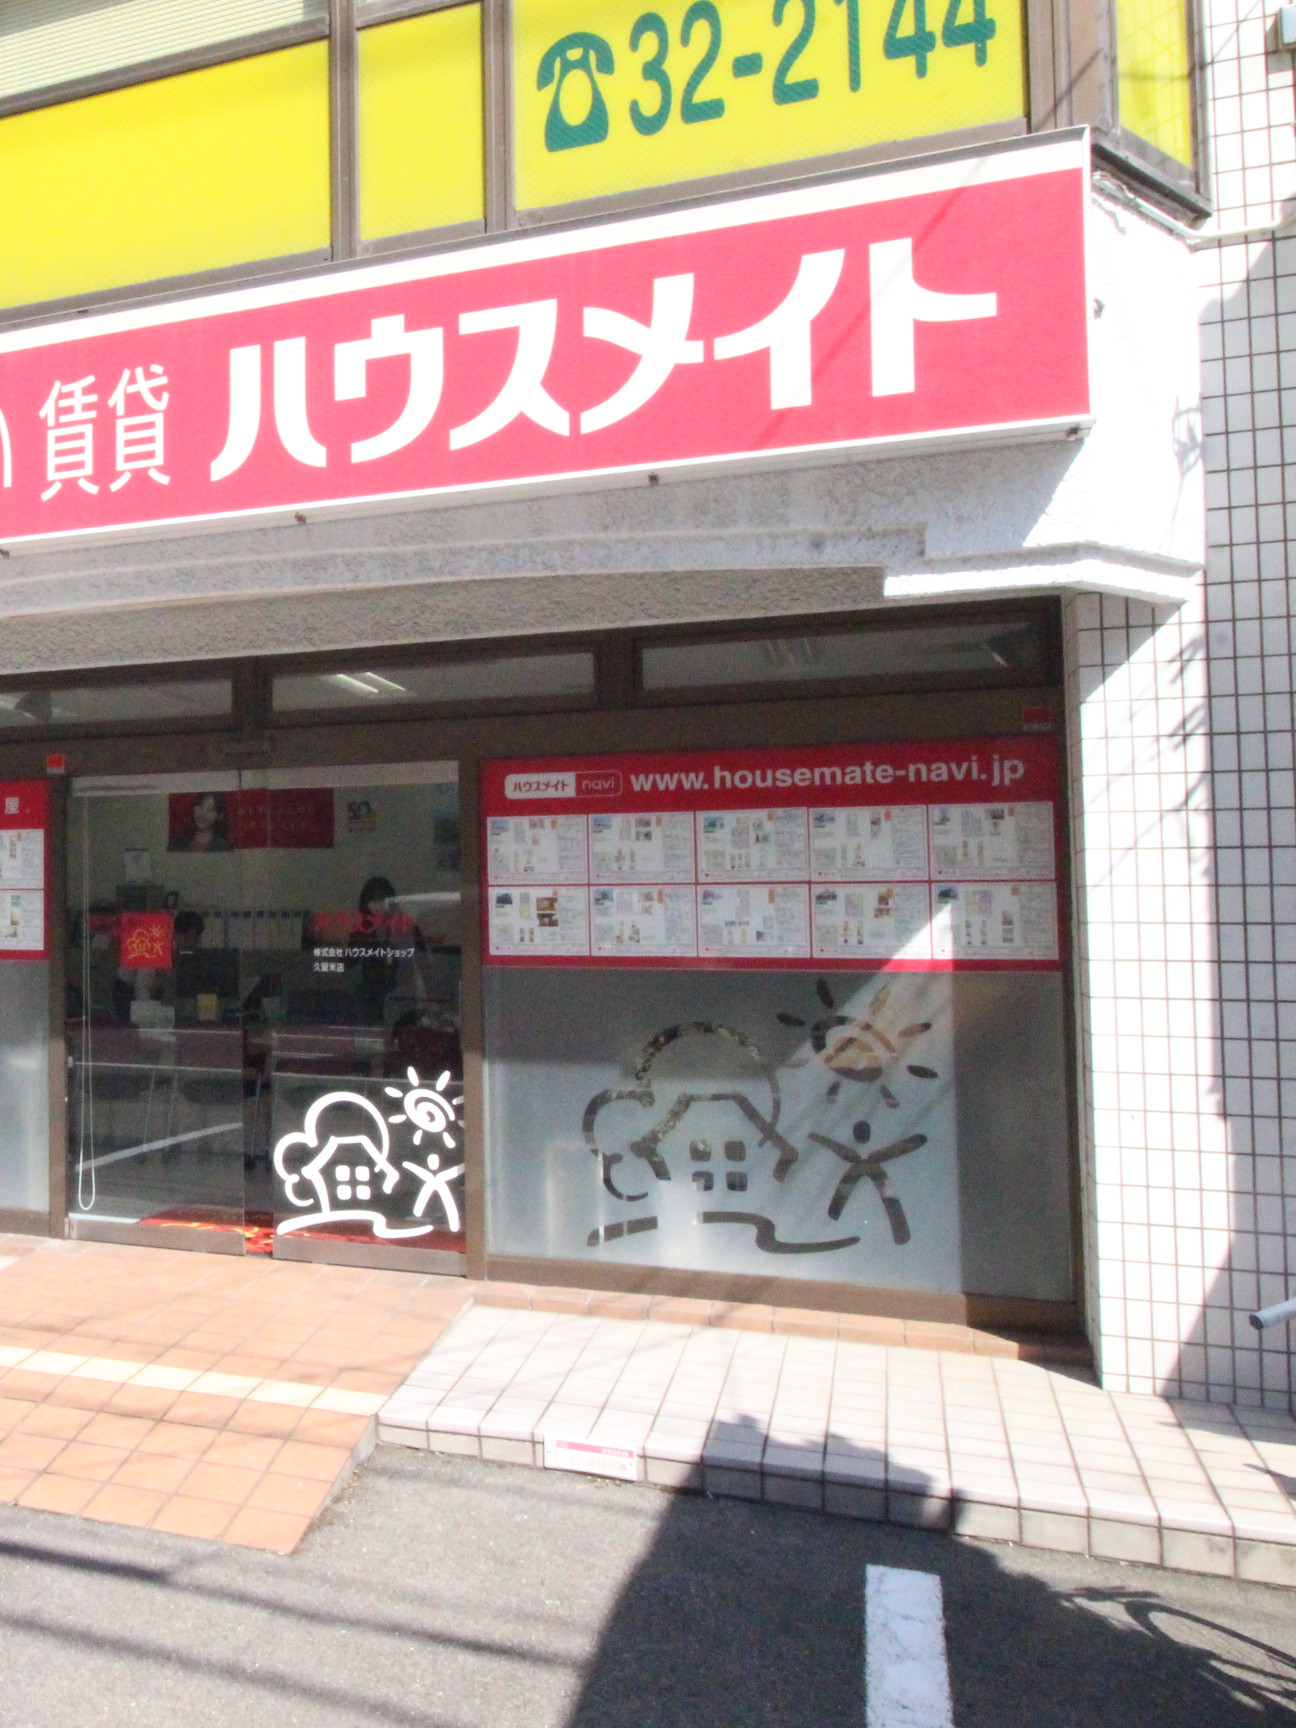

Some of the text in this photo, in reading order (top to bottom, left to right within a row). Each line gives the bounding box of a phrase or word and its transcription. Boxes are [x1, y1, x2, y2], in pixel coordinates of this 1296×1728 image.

[629, 0, 997, 136] 32-2144
[39, 364, 170, 502] 賃貸
[210, 238, 998, 482] ハウスメイト
[512, 754, 1025, 793] ハウスメイト navi www.housemate-navi.jp
